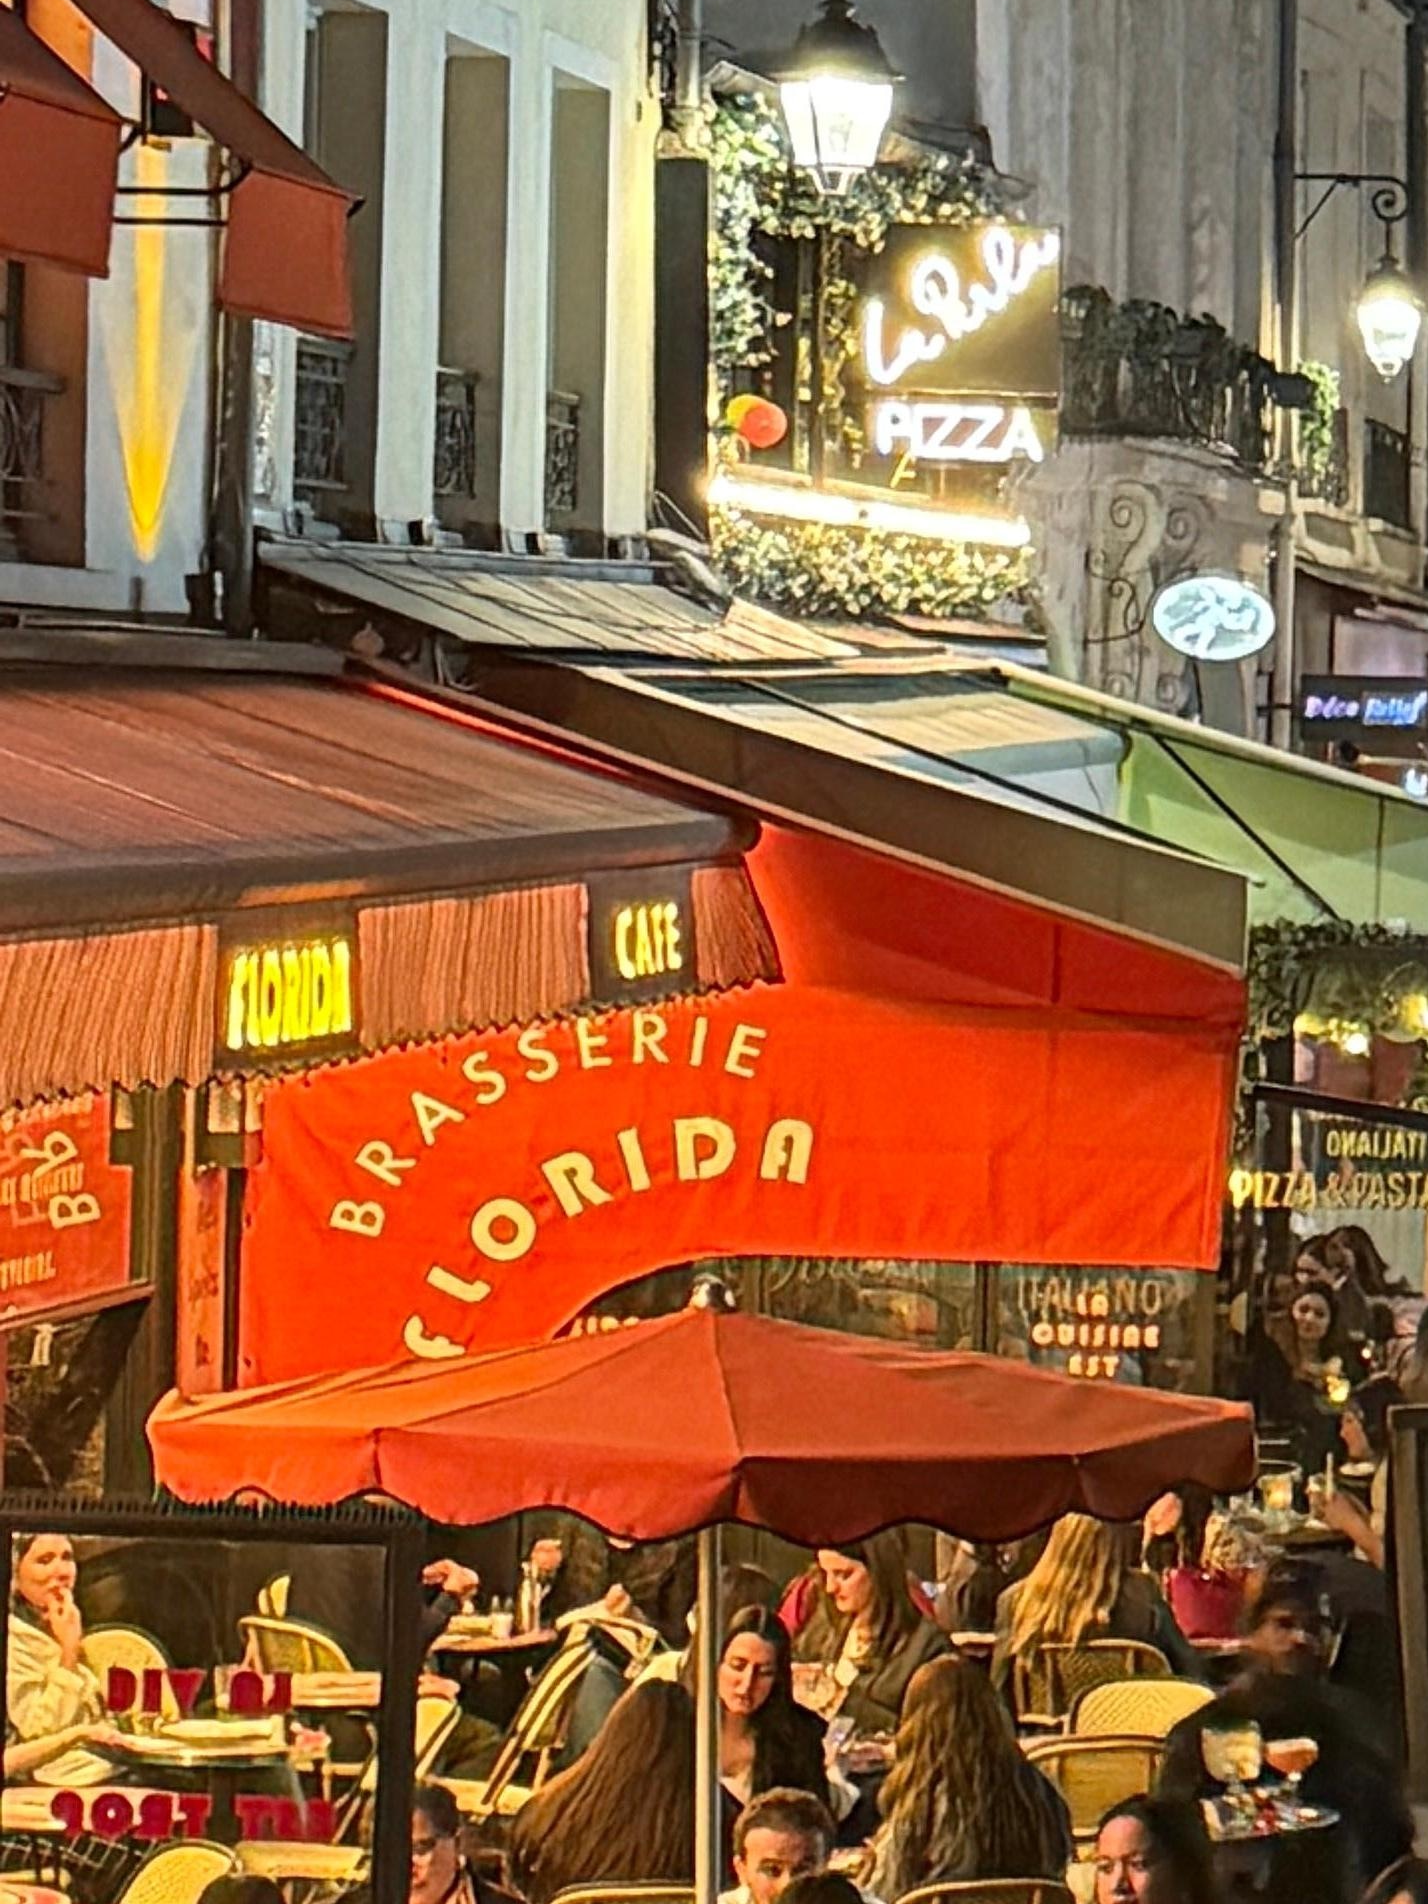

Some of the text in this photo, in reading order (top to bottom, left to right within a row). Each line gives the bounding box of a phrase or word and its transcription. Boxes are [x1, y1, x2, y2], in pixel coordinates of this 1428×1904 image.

[875, 402, 1043, 462] PIZZA
[226, 939, 352, 1050] FLORIDA
[329, 1009, 768, 1237] BRASSERIE
[1229, 1169, 1317, 1210] PIZZA
[402, 1115, 813, 1360] FLORIDA
[1032, 1323, 1160, 1348] CUISINE
[1069, 1352, 1120, 1378] EST
